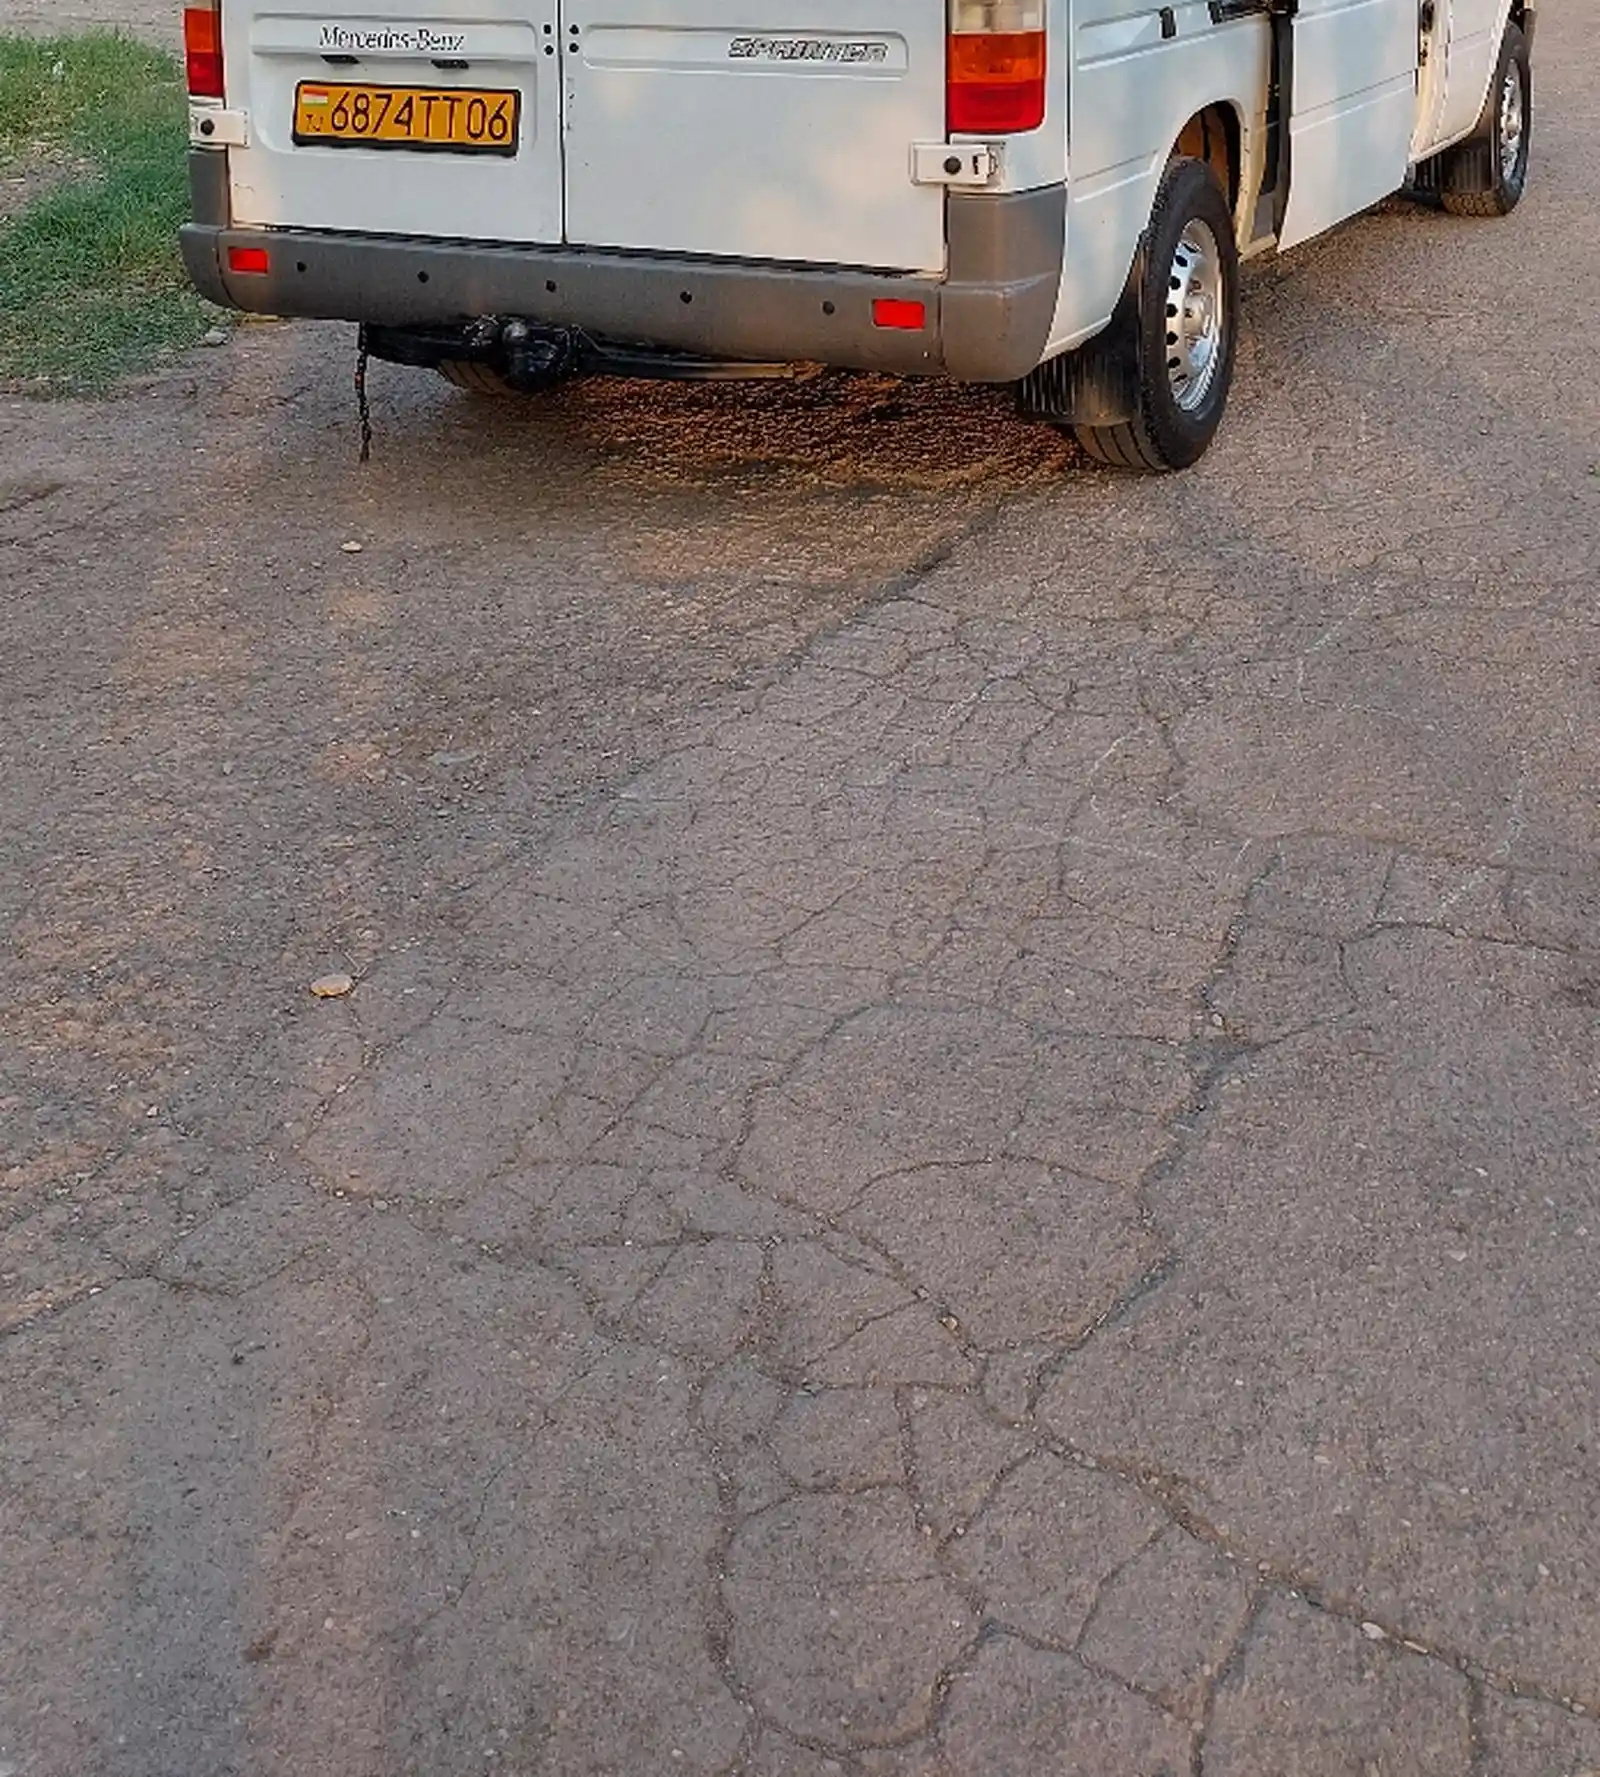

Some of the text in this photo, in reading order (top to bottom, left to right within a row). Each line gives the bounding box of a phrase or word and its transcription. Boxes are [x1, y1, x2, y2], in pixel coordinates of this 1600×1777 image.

[319, 26, 465, 52] Mercedes-Benz
[728, 37, 888, 63] SPRINTER
[331, 90, 508, 141] 6874TT06
